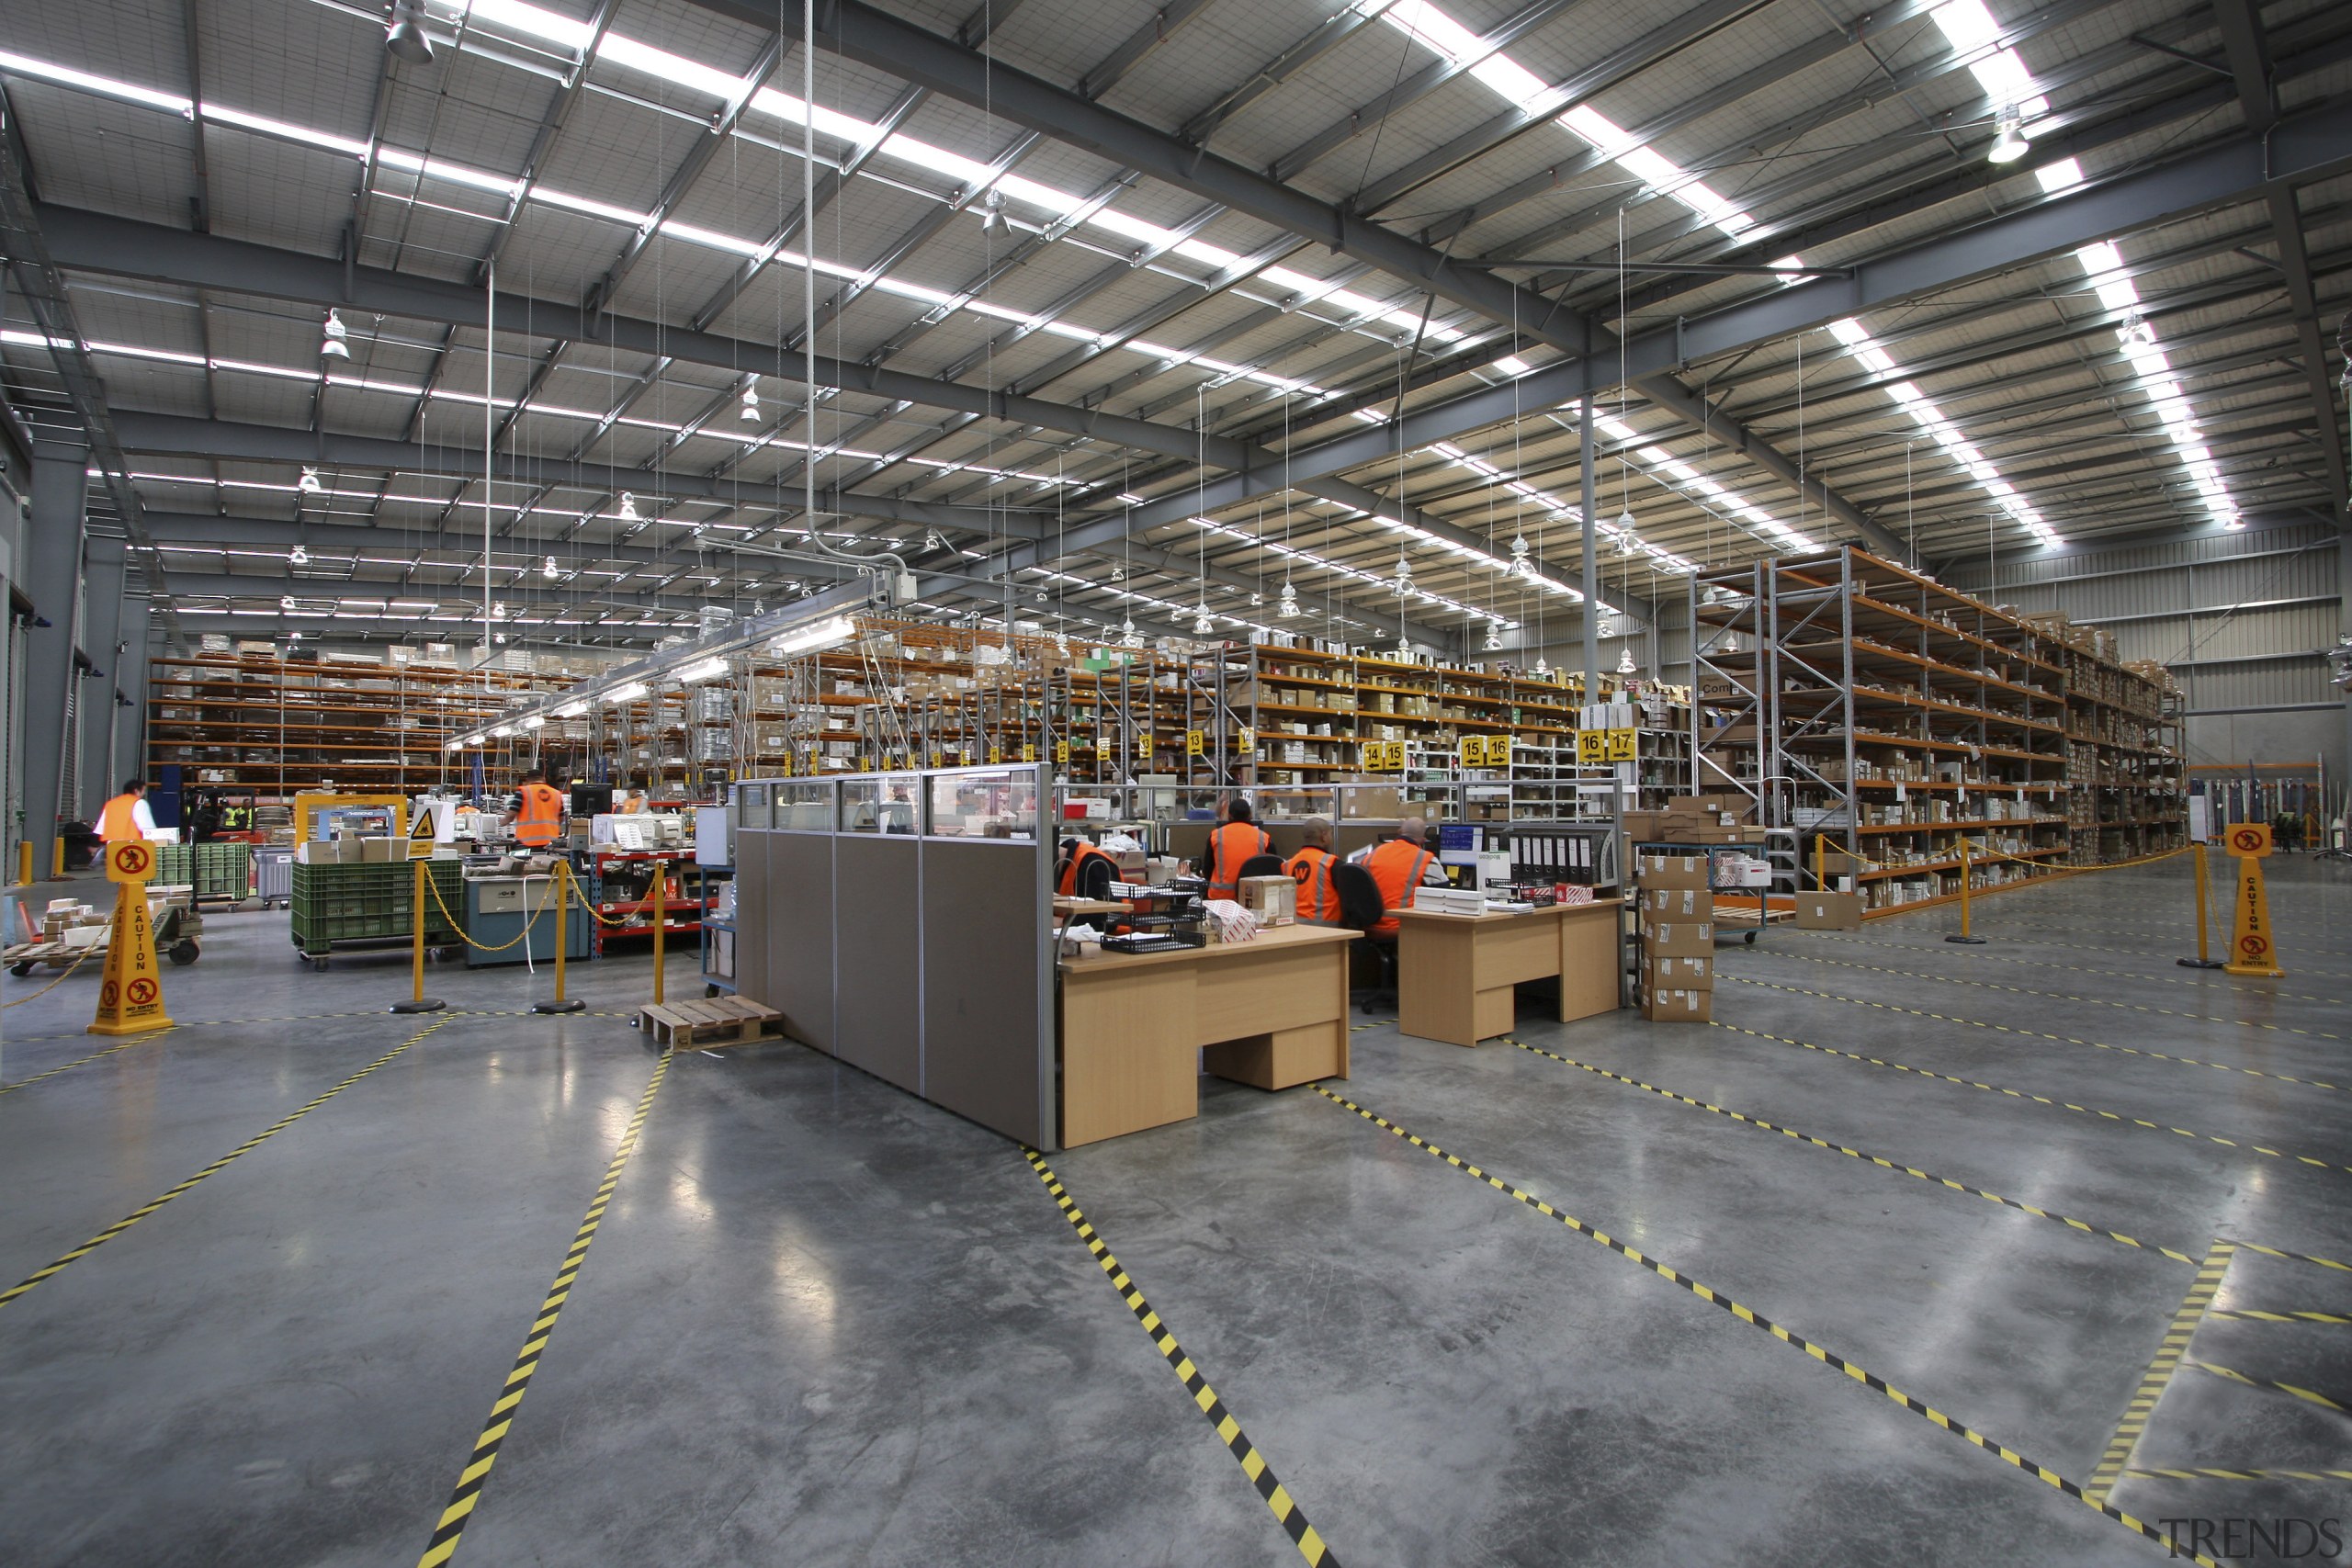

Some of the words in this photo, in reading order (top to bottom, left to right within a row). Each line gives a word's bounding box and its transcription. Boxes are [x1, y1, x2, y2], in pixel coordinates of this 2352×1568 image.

[1190, 735, 1200, 746] 13
[1491, 740, 1506, 754] 16
[1582, 735, 1599, 750] 16
[1612, 733, 1632, 749] 17
[991, 750, 998, 759] 11
[1025, 748, 1032, 757] 11
[1059, 745, 1067, 755] 12
[1367, 749, 1378, 761] 14
[1388, 746, 1401, 759] 15
[1465, 742, 1479, 756] 15
[1295, 868, 1308, 879] W
[2246, 877, 2258, 931] CAUTION
[110, 906, 123, 971] CAUTION
[134, 905, 145, 970] CAUTION
